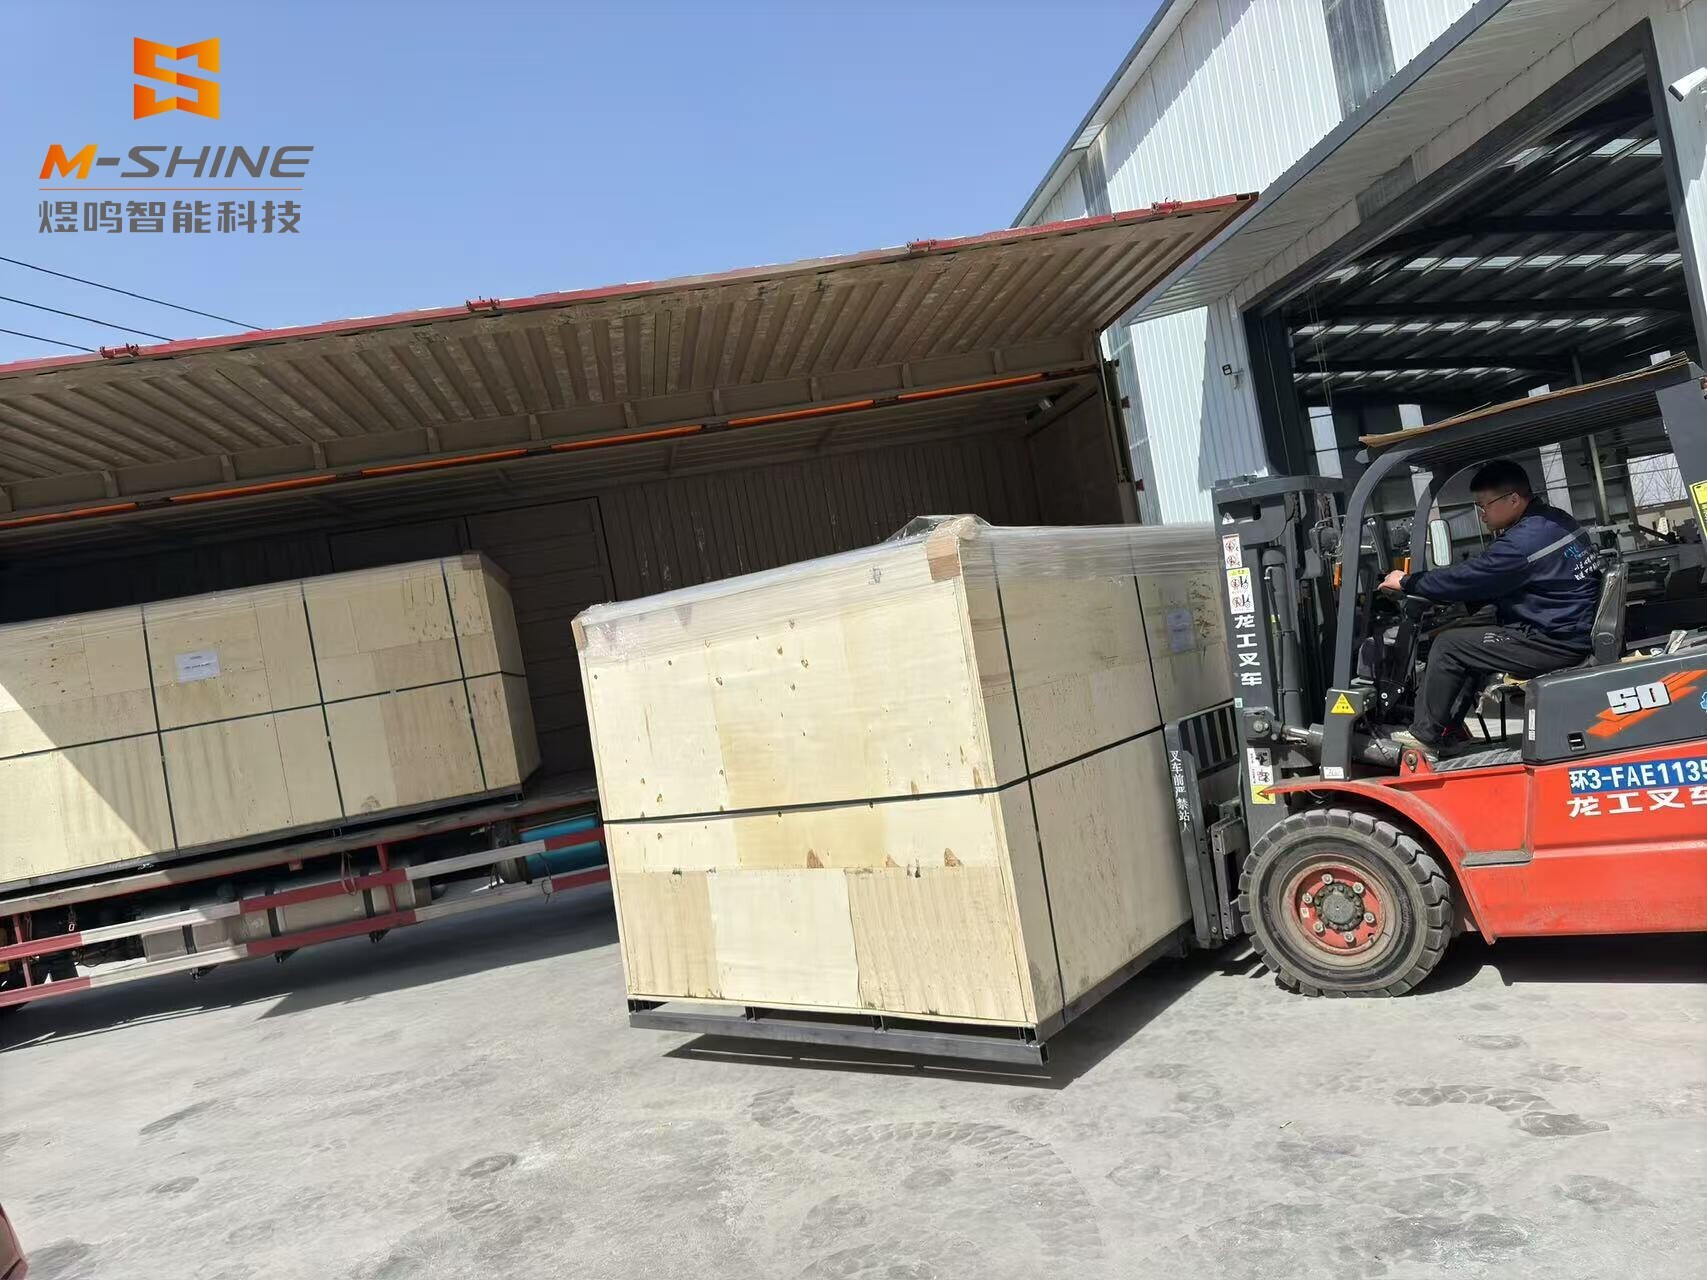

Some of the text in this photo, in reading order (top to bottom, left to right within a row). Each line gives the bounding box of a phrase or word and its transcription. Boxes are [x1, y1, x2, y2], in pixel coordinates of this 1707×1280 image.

[1234, 614, 1262, 686] 龙工叉车
[1606, 681, 1671, 715] 50
[1169, 750, 1190, 832] 叉车前严禁站人
